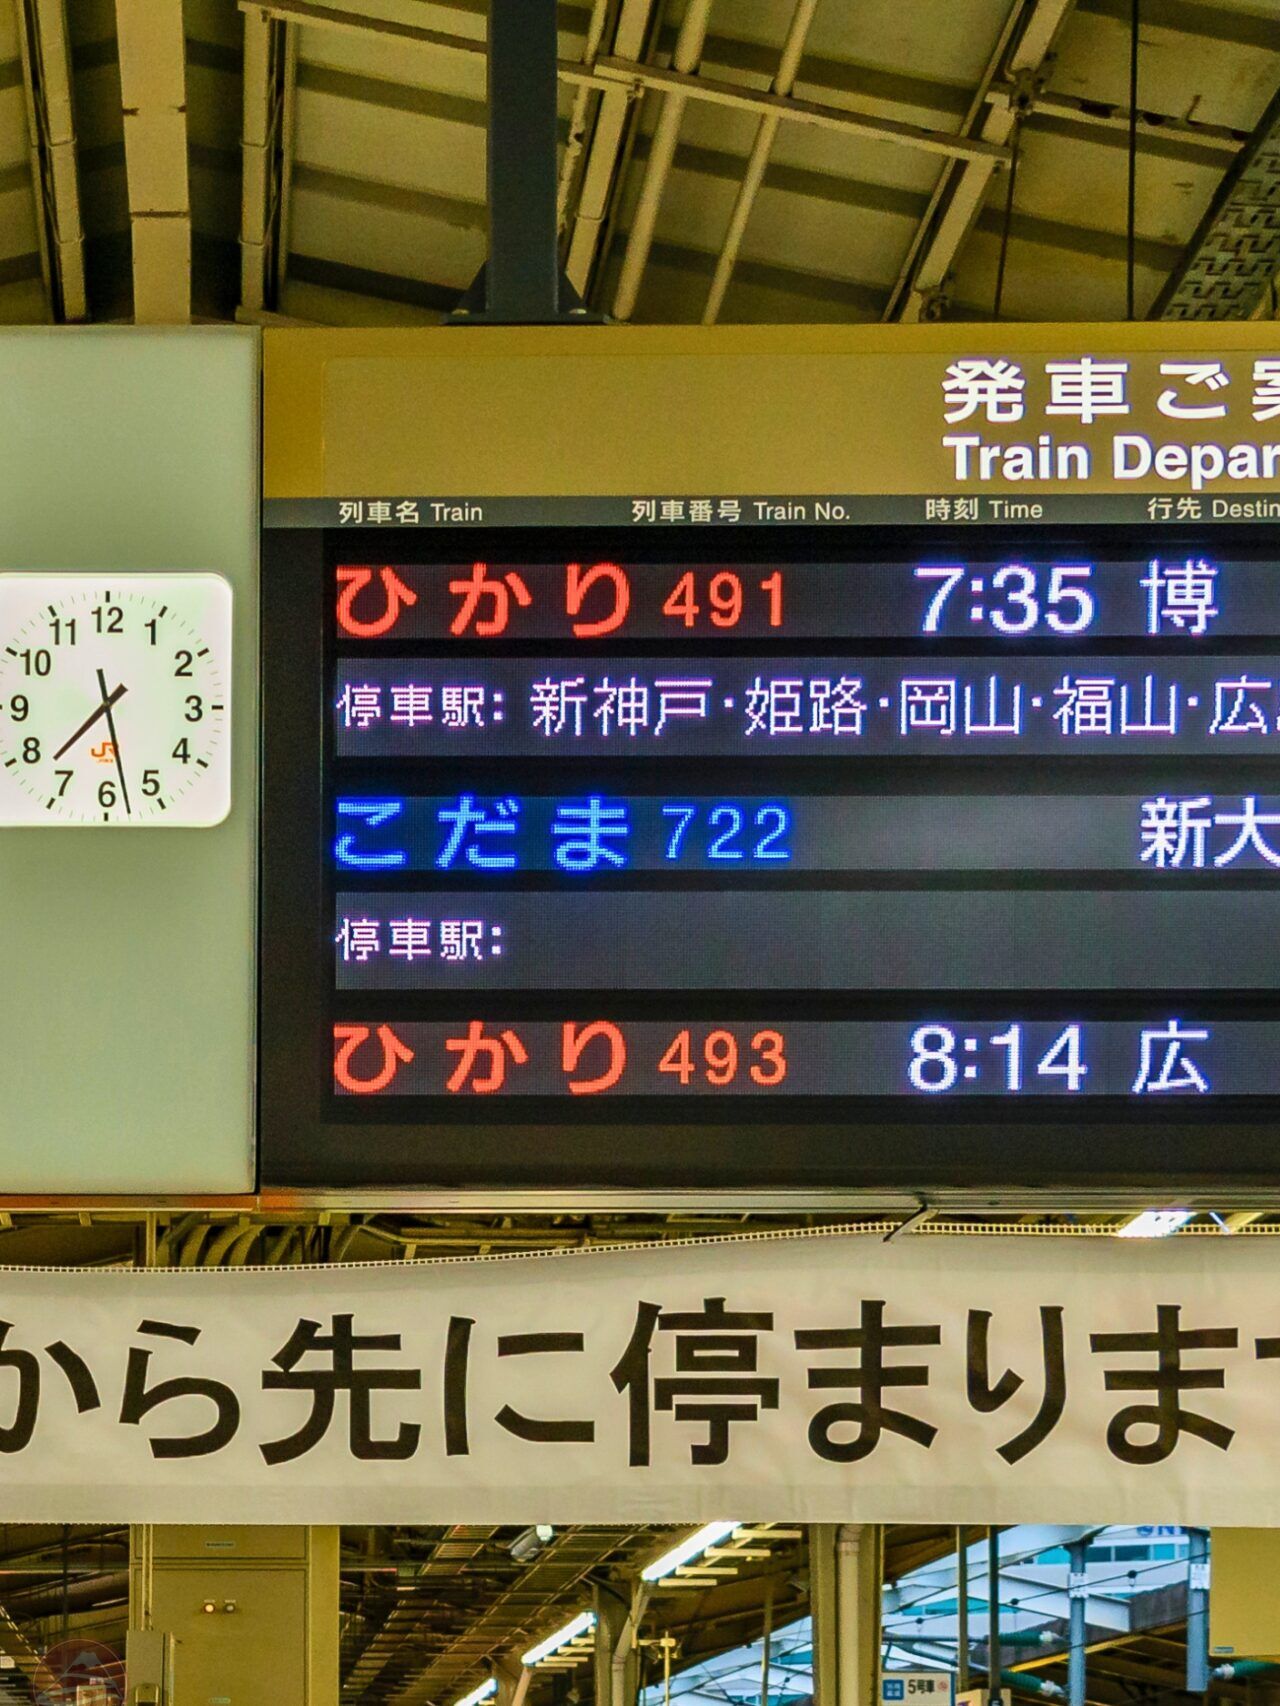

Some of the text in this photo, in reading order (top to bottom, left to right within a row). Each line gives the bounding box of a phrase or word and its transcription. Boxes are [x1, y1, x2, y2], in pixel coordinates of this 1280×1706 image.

[942, 435, 1089, 481] Train
[339, 500, 483, 524] 列車名 Train
[631, 499, 851, 523] 列車番号 Train No.
[925, 497, 1043, 521] 時刻 Time
[1147, 496, 1202, 520] 行先
[662, 570, 785, 628] 491
[914, 564, 1094, 634] 7:35
[49, 618, 76, 646] 11
[91, 606, 124, 633] 12
[144, 618, 157, 646] 1
[19, 648, 52, 676] 10
[174, 650, 193, 677] 2
[10, 694, 29, 722] 9
[184, 695, 203, 722] 3
[22, 736, 41, 764] 8
[172, 737, 191, 764] 4
[54, 770, 74, 797] 7
[98, 780, 117, 808] 6
[141, 769, 160, 797] 5
[662, 804, 790, 861] 722
[658, 1029, 787, 1086] 493
[908, 1024, 1088, 1093] 8:14
